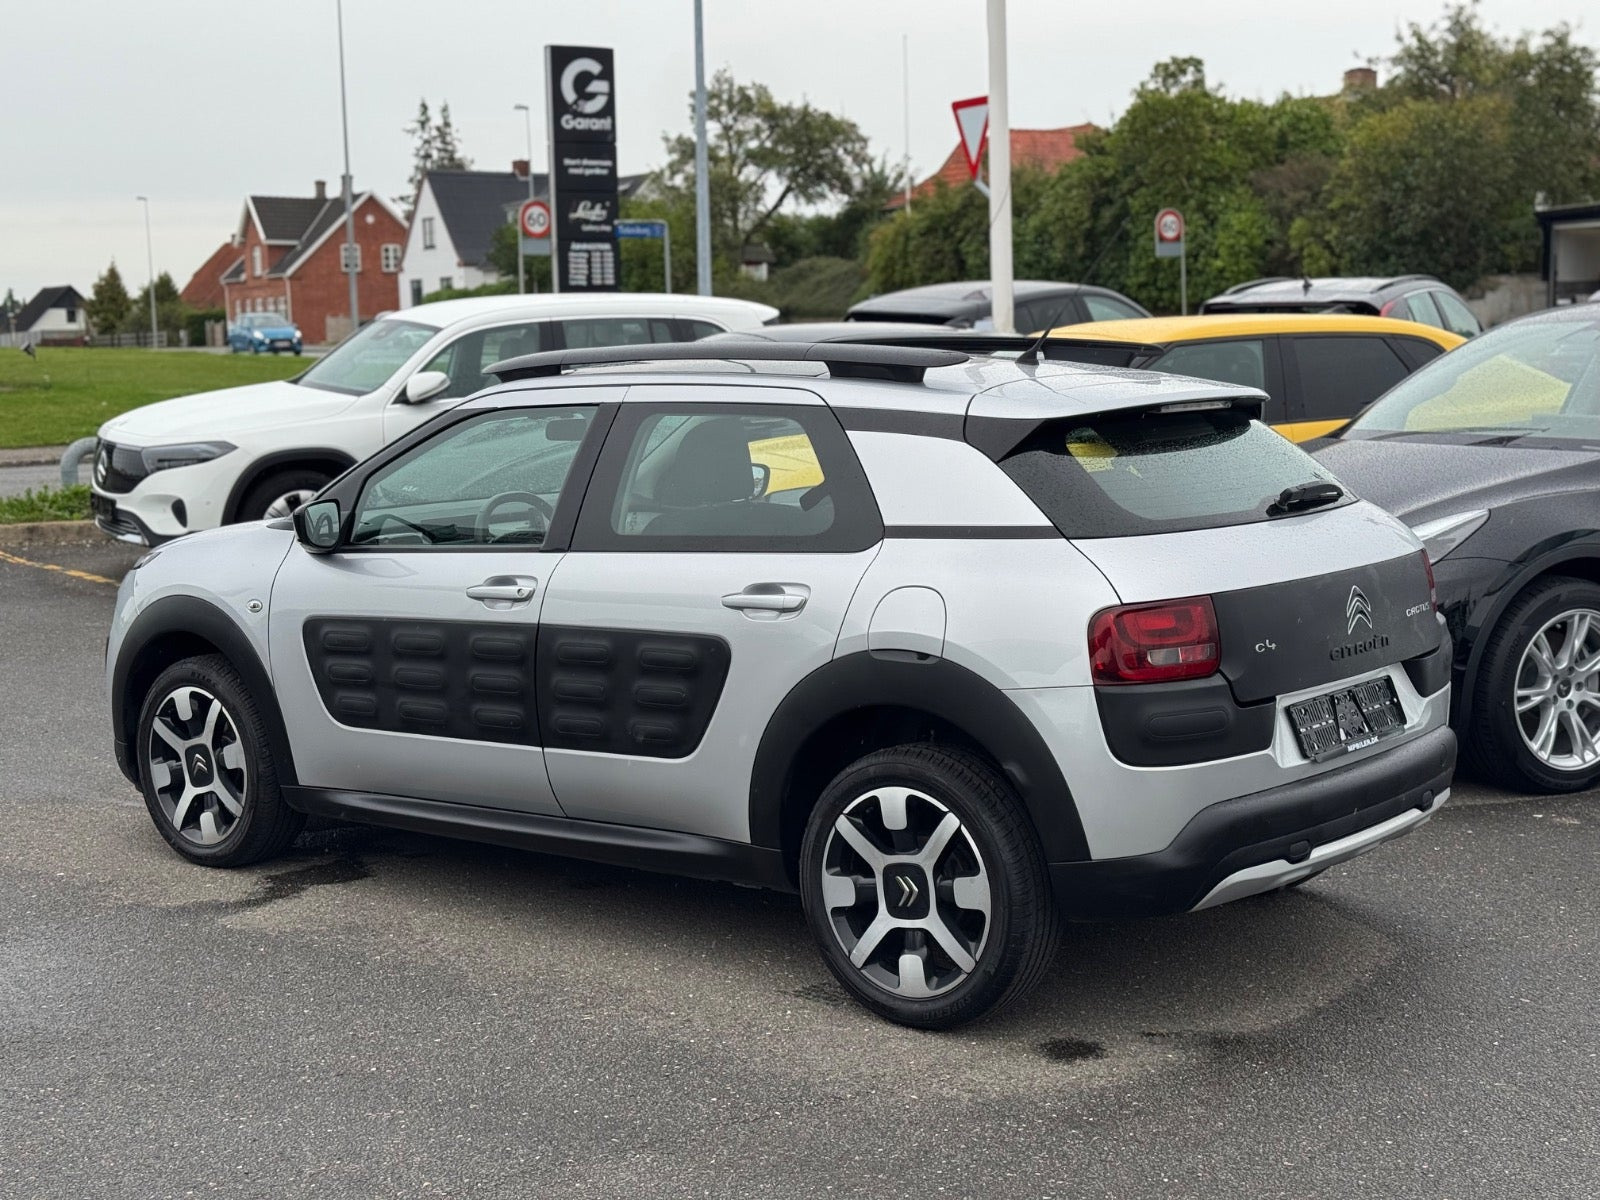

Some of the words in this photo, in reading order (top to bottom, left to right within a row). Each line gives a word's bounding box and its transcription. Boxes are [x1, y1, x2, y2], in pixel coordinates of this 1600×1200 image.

[561, 114, 612, 131] Garant
[527, 211, 547, 228] 60
[1406, 602, 1430, 617] CACTUS
[1255, 639, 1277, 653] C4
